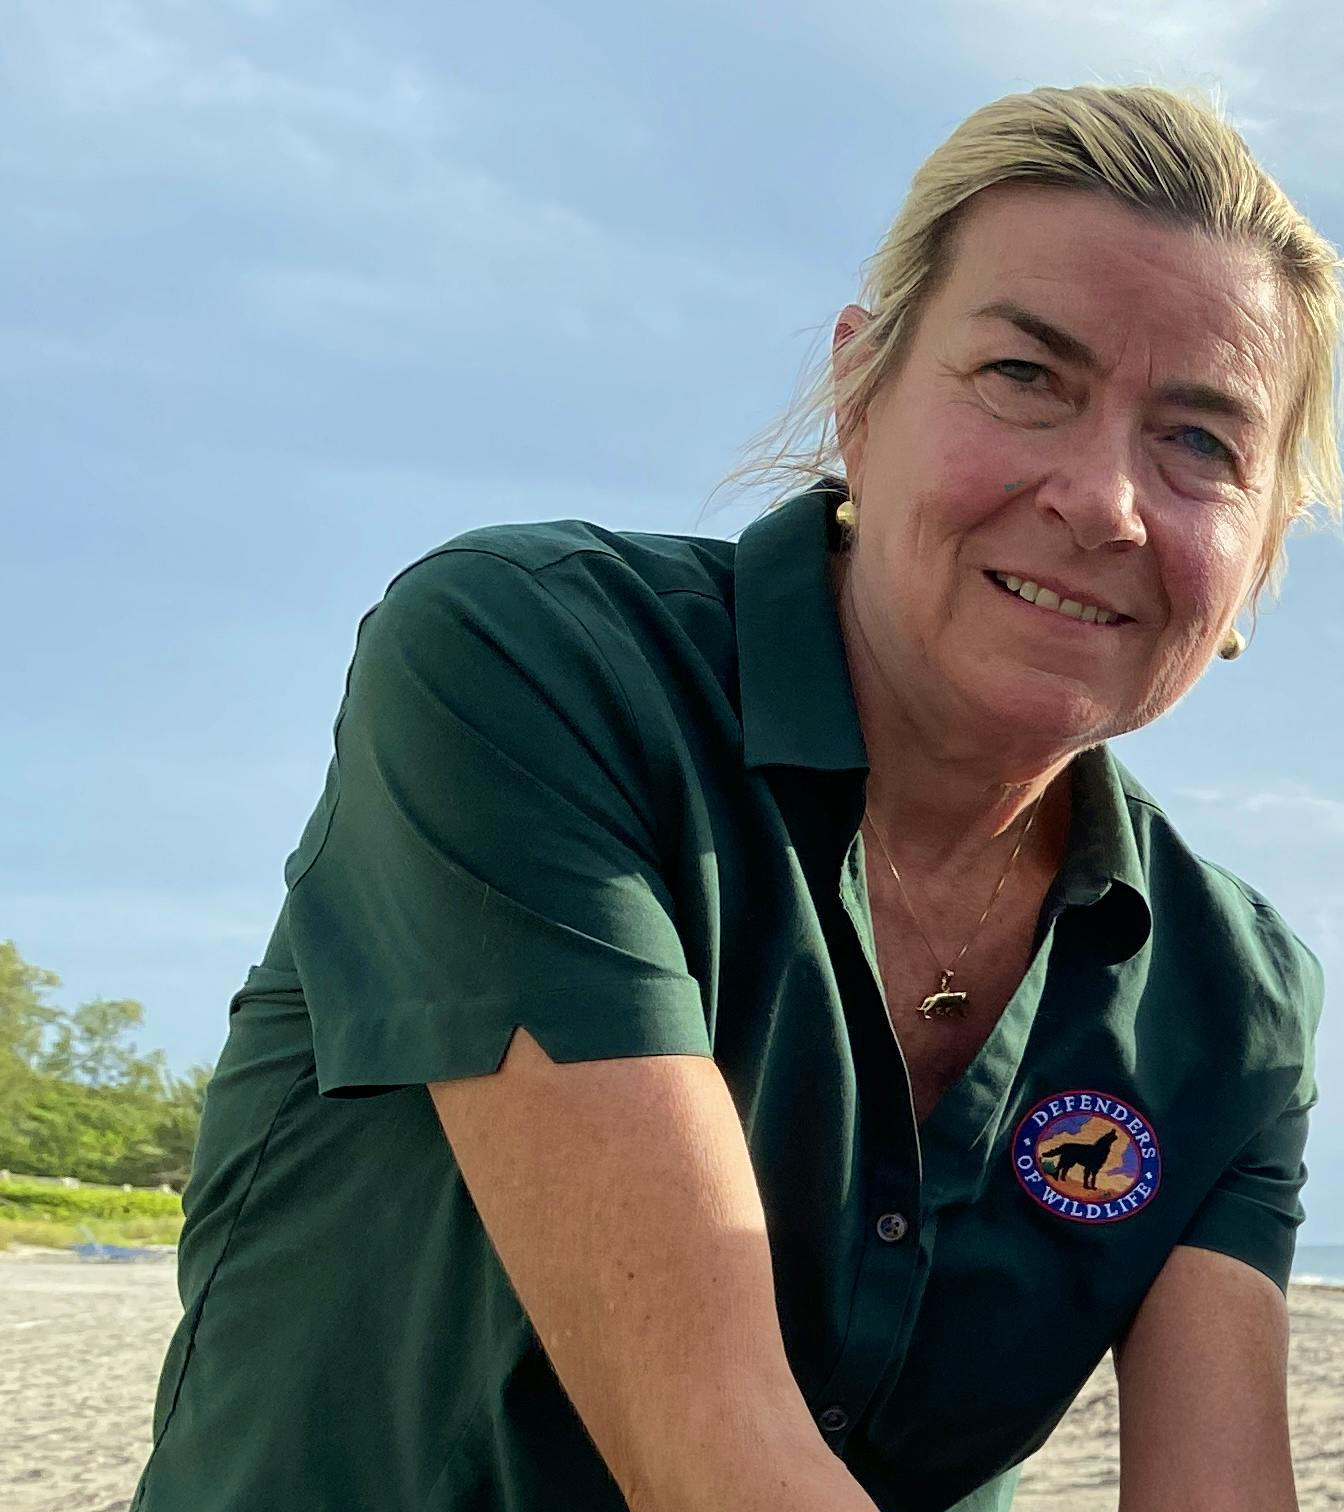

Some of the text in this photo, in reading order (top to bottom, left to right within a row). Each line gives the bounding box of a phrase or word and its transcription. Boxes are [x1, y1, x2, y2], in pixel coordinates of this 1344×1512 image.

[1032, 1094, 1156, 1159] DEFENDERS
[1017, 1155, 1151, 1219] OF WILDLIFE
